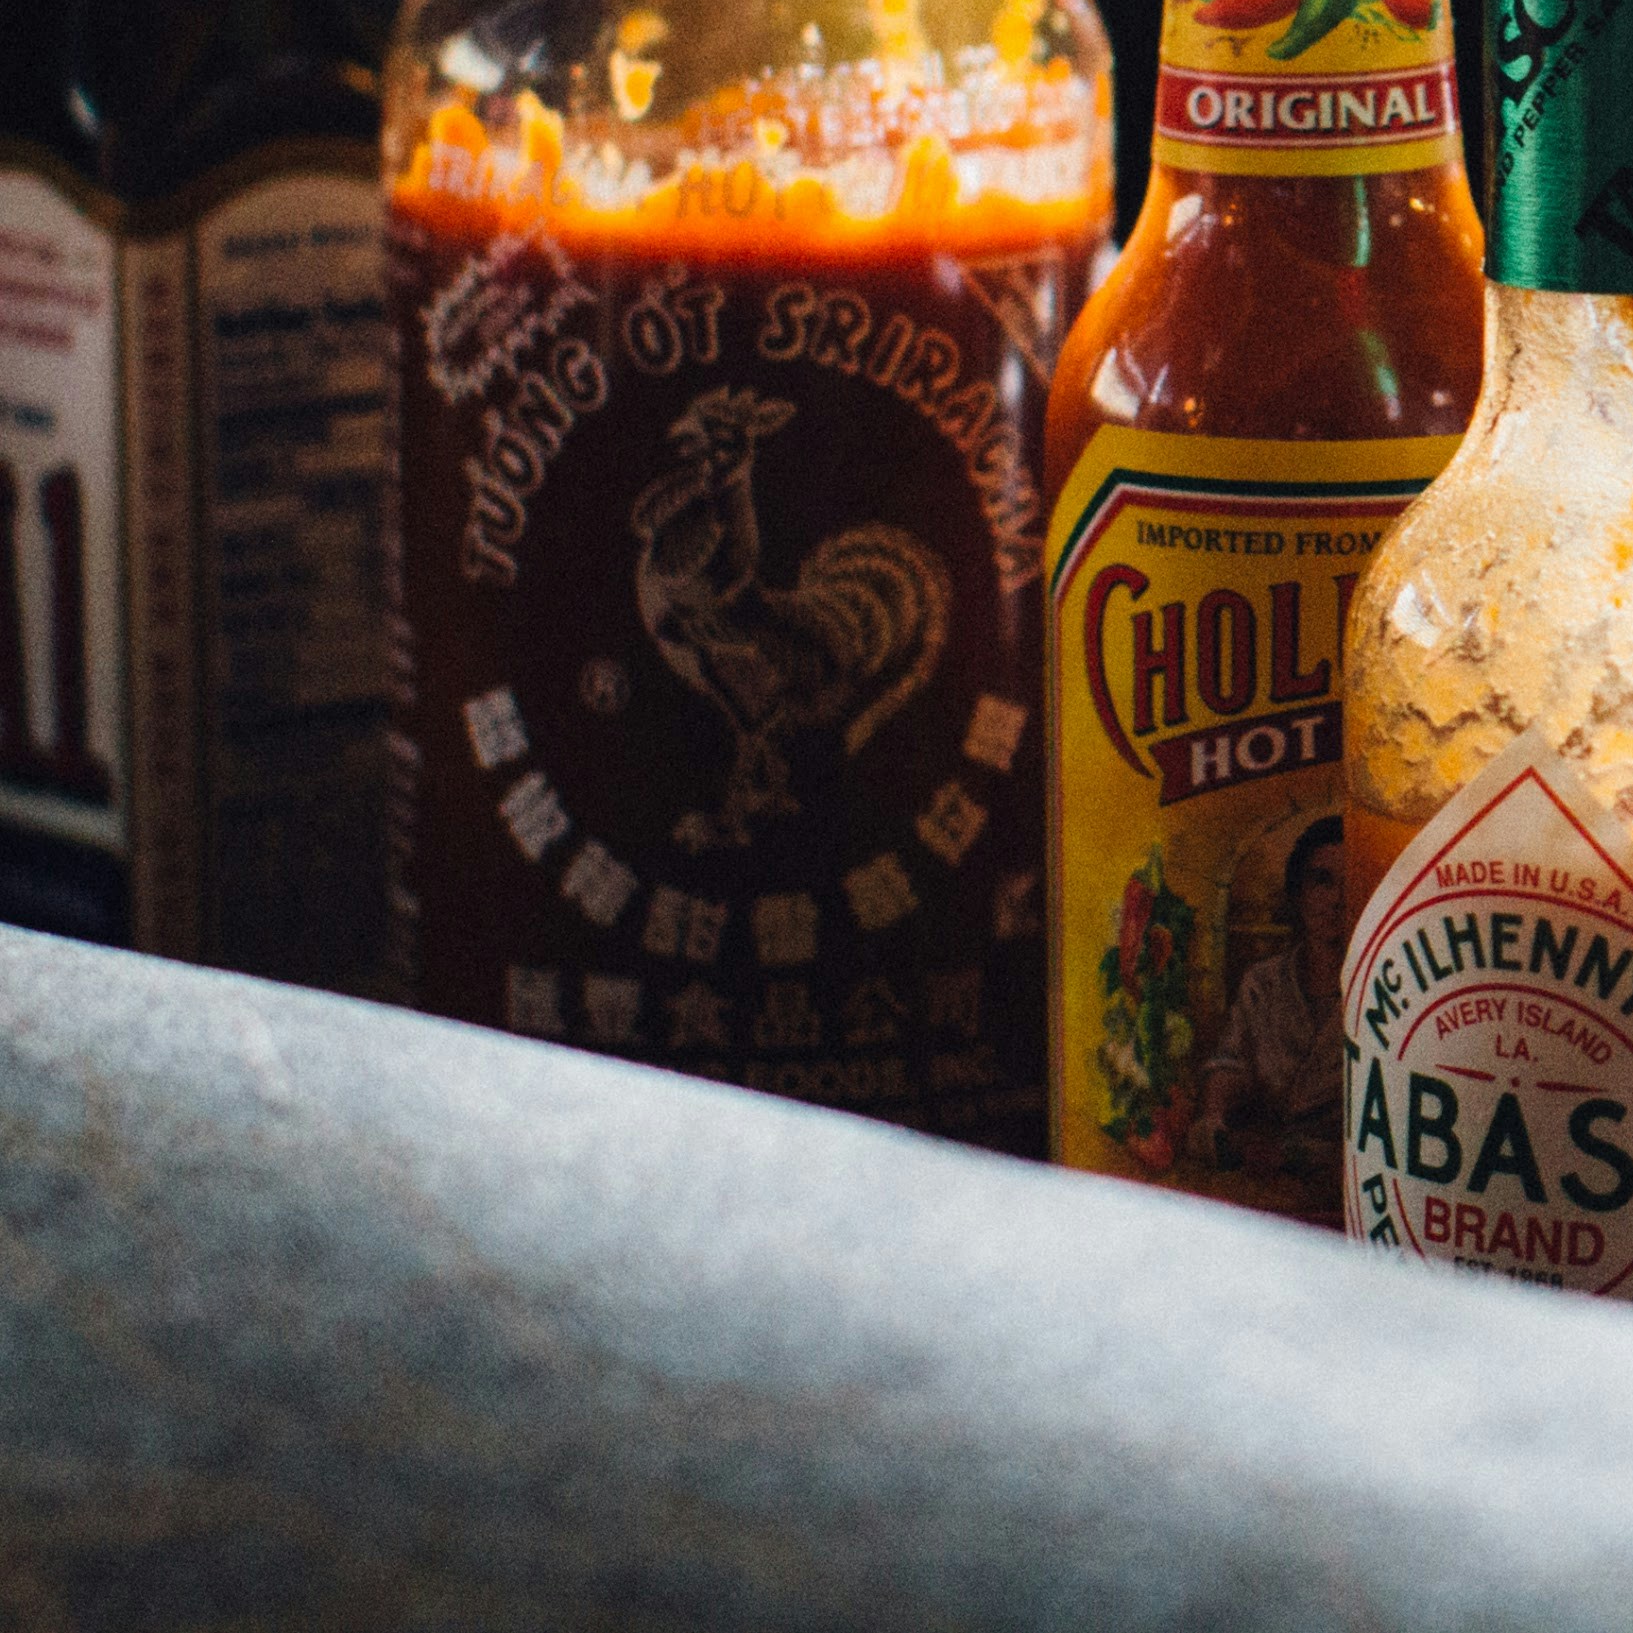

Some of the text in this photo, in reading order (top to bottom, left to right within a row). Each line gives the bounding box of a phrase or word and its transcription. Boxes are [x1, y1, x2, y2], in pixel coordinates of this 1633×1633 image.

[1186, 84, 1437, 133] ORIGINAL
[1135, 519, 1383, 556] IMPORTED FROM
[1083, 562, 1360, 781] CHOL
[1189, 714, 1328, 788] HOT
[1435, 860, 1630, 916] MADE IN U.S.A.
[1434, 998, 1614, 1066] AVERY ISLAND
[1495, 1034, 1539, 1063] LA.
[1423, 1195, 1607, 1267] BRAND
